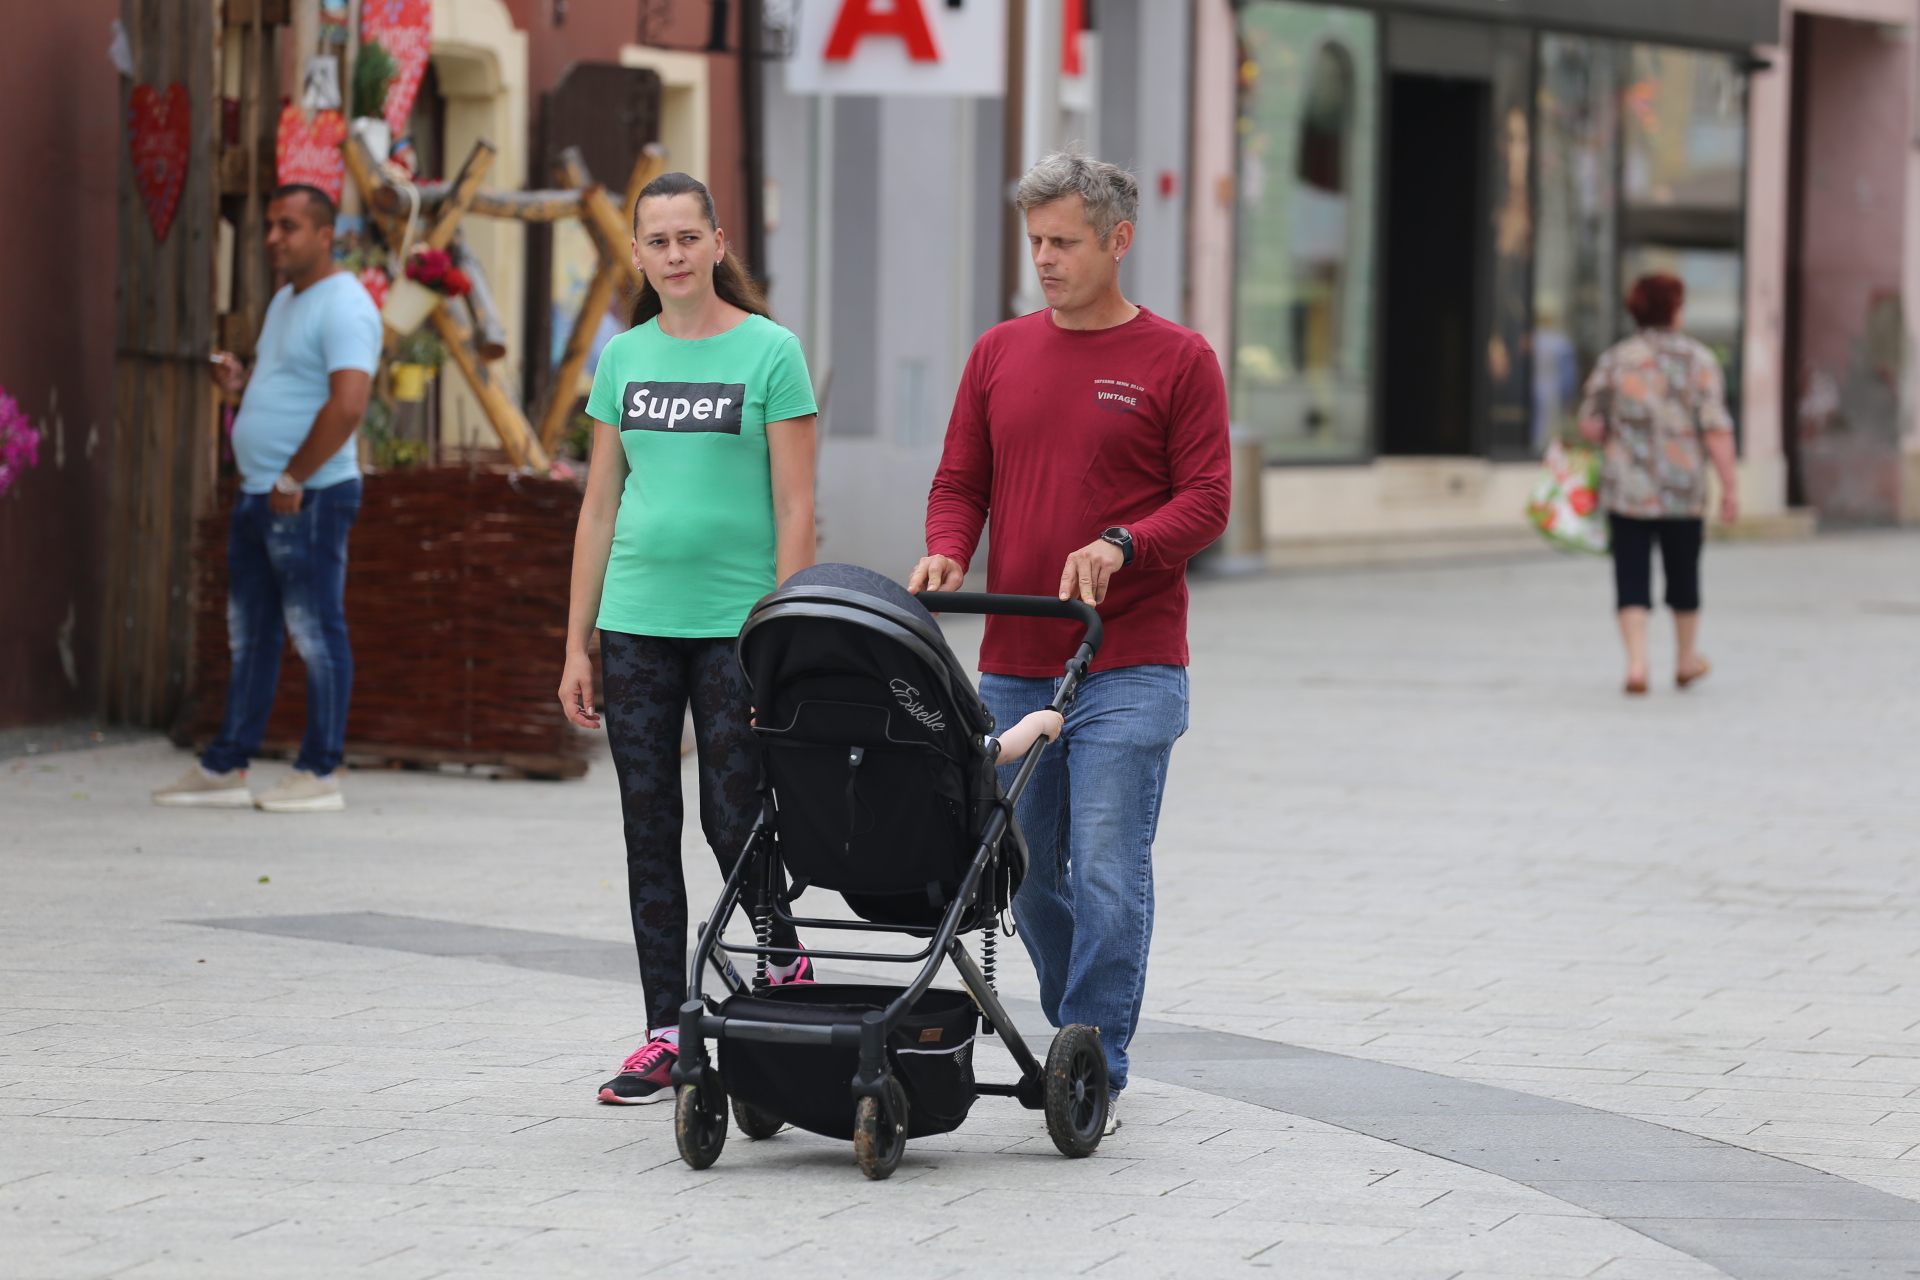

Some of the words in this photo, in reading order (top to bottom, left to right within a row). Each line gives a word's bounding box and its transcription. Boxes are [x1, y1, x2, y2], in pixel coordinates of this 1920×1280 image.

[628, 388, 732, 428] Super
[1097, 391, 1137, 406] VINTAGE
[889, 678, 945, 731] Estelle
